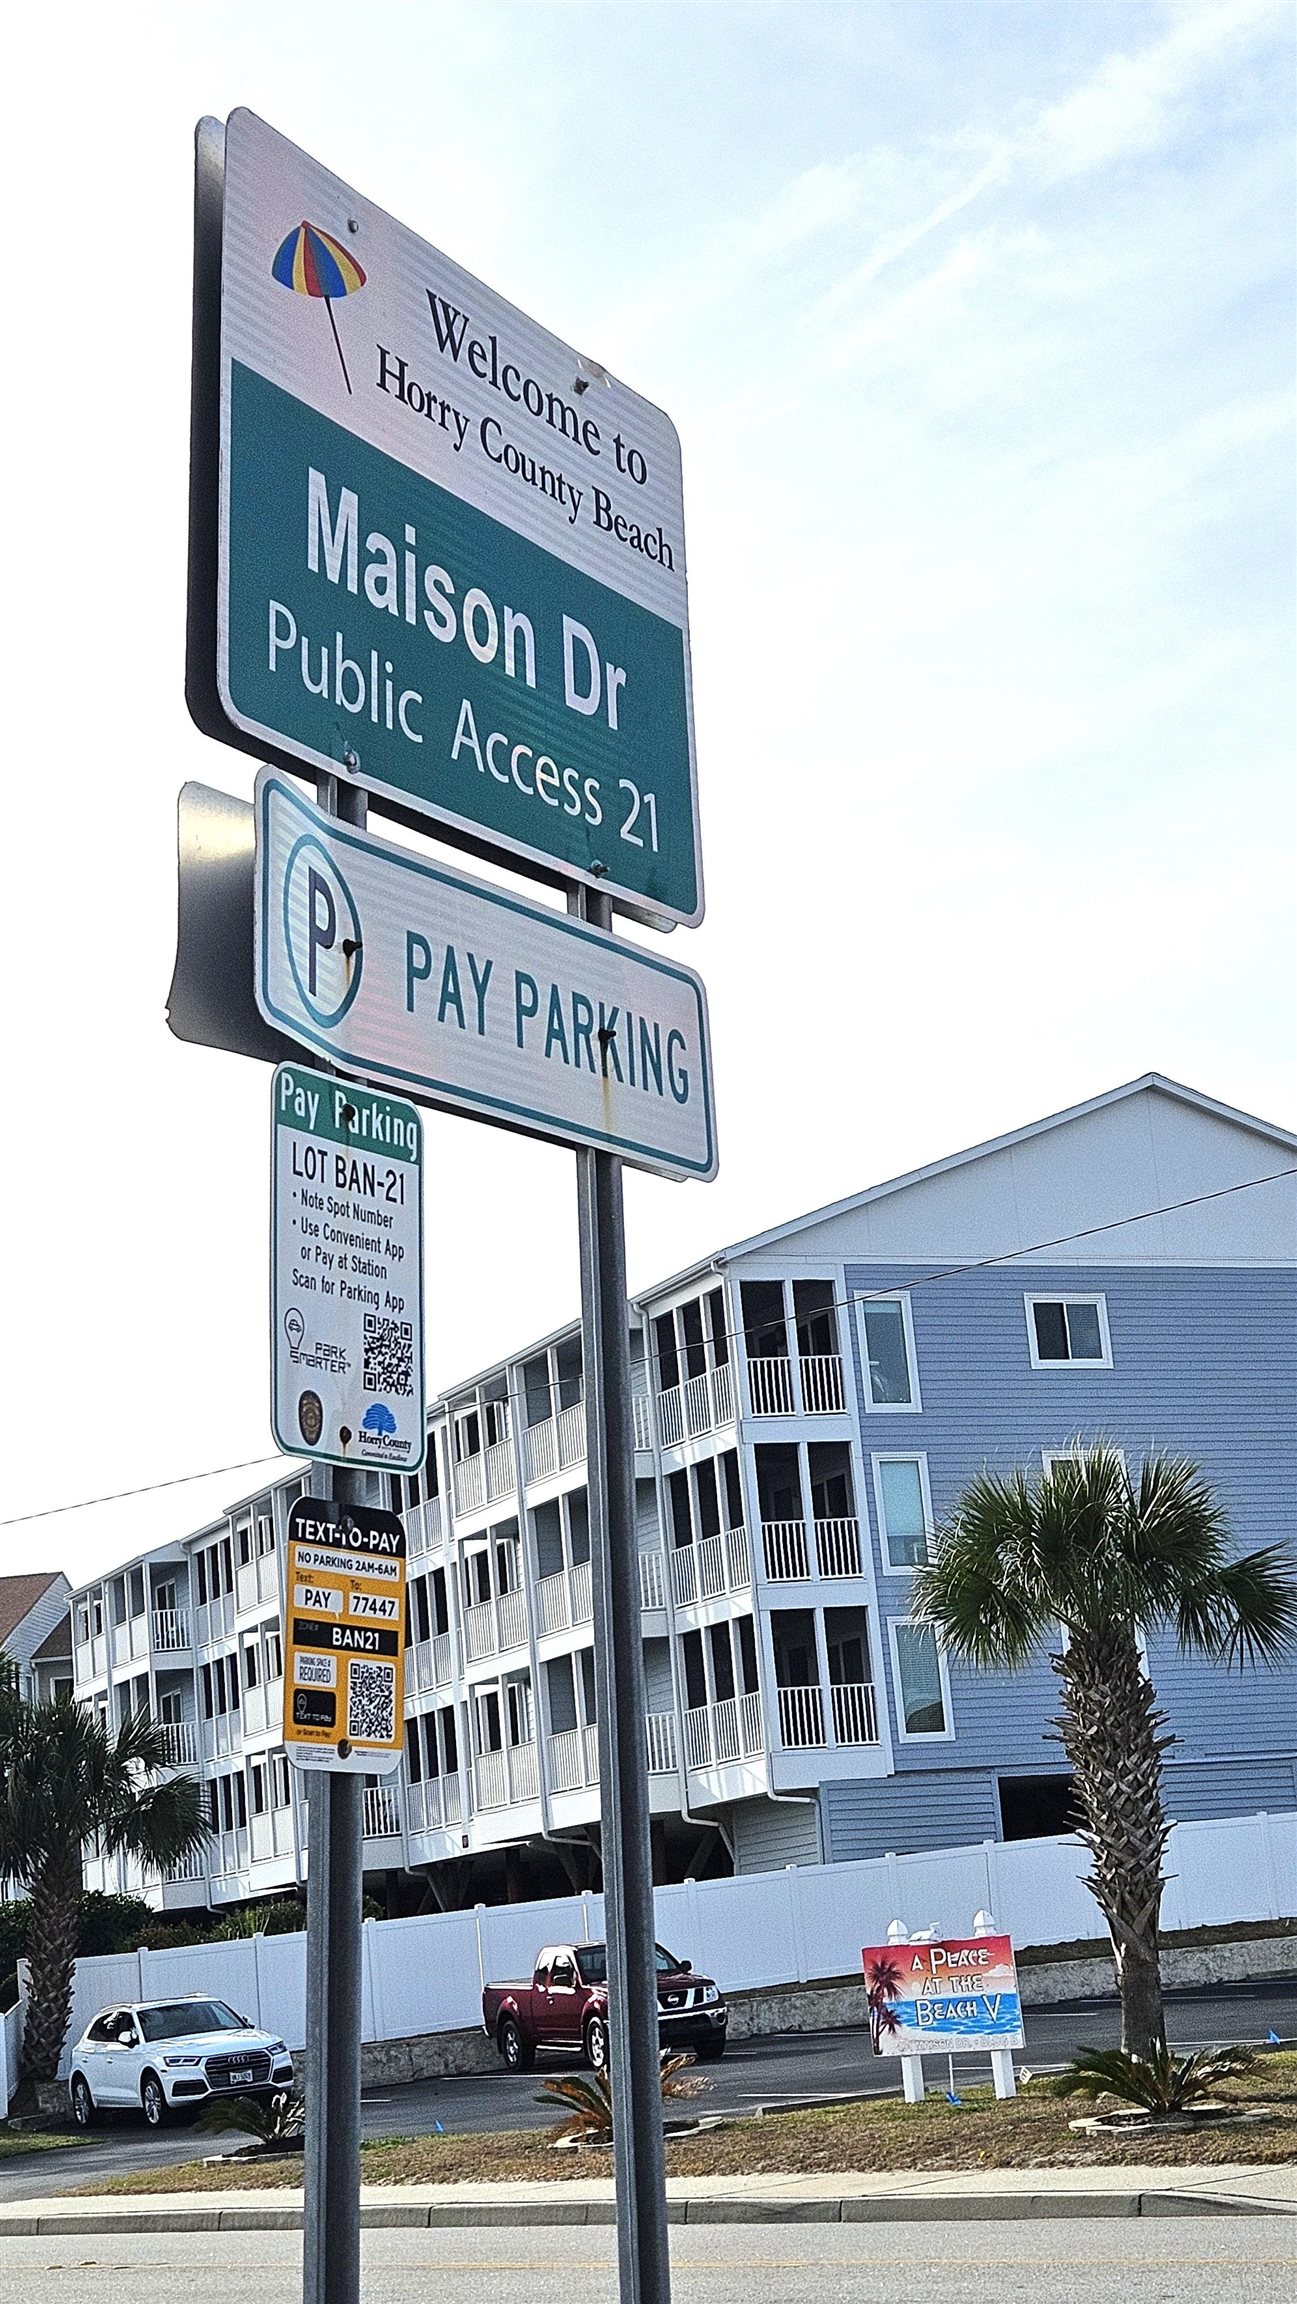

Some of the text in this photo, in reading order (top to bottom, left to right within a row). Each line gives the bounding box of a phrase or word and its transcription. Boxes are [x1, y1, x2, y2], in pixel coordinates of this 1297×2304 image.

[426, 289, 648, 486] Welcome to
[376, 344, 675, 573] Horry County Beach
[307, 466, 627, 731] Maison Dr
[268, 600, 661, 853] Public Access 21
[307, 865, 336, 997] P
[406, 929, 690, 1105] PAY PARKING
[280, 1071, 418, 1163] Pay Parking
[292, 1141, 405, 1206] LOT BAN-21
[301, 1188, 394, 1229] Note Spot Number
[301, 1216, 405, 1263] Use Convenient App
[300, 1245, 388, 1280] or Pay at Station
[292, 1268, 405, 1315] Scan for Parking App
[297, 1551, 398, 1577] NO PARKING 2AM-6AM
[304, 1588, 332, 1609] PAY
[352, 1595, 396, 1617] 77447
[332, 1627, 380, 1651] BAN21
[299, 1665, 332, 1683] REQUIRED
[911, 1953, 925, 1973] A
[922, 1974, 985, 1996] AT THE
[915, 1993, 1002, 2027] BEACH V
